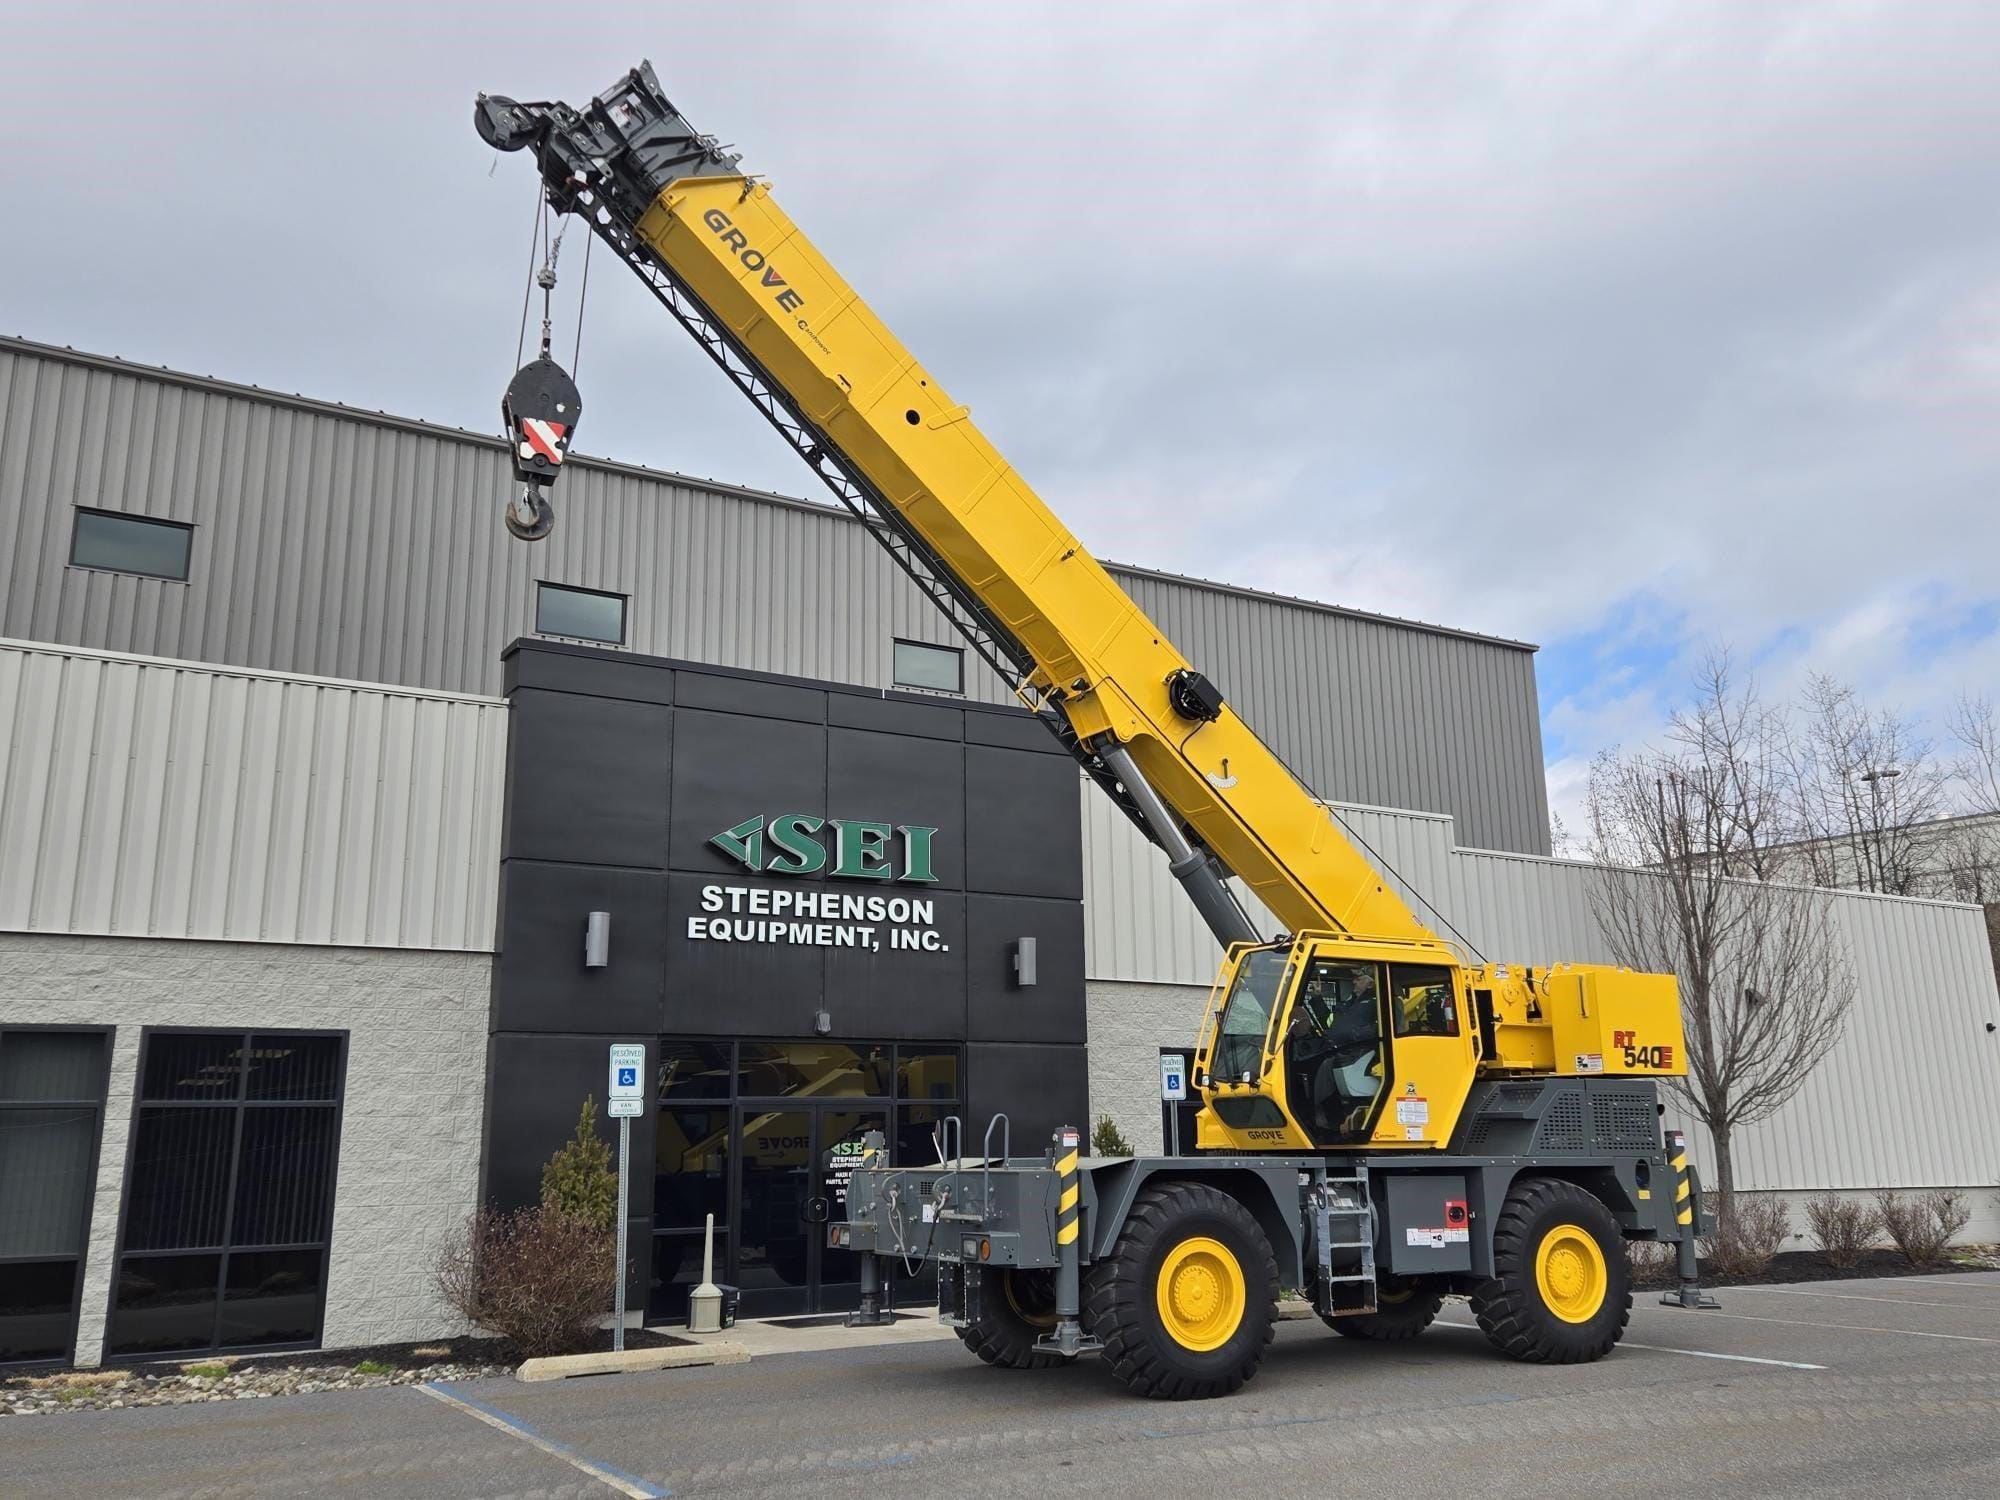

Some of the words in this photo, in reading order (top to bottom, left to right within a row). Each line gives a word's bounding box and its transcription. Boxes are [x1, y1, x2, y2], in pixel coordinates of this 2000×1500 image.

[703, 208, 804, 314] GROVE
[767, 814, 939, 881] SEI
[700, 885, 934, 925] STEPHENSON
[687, 917, 879, 952] EQUIPMENT,
[890, 928, 949, 951] INC.
[1613, 1030, 1636, 1048] RT
[612, 1049, 641, 1057] RESERVED
[1624, 1046, 1673, 1069] 540E
[1247, 1130, 1285, 1139] GROVE
[840, 1142, 864, 1155] SE
